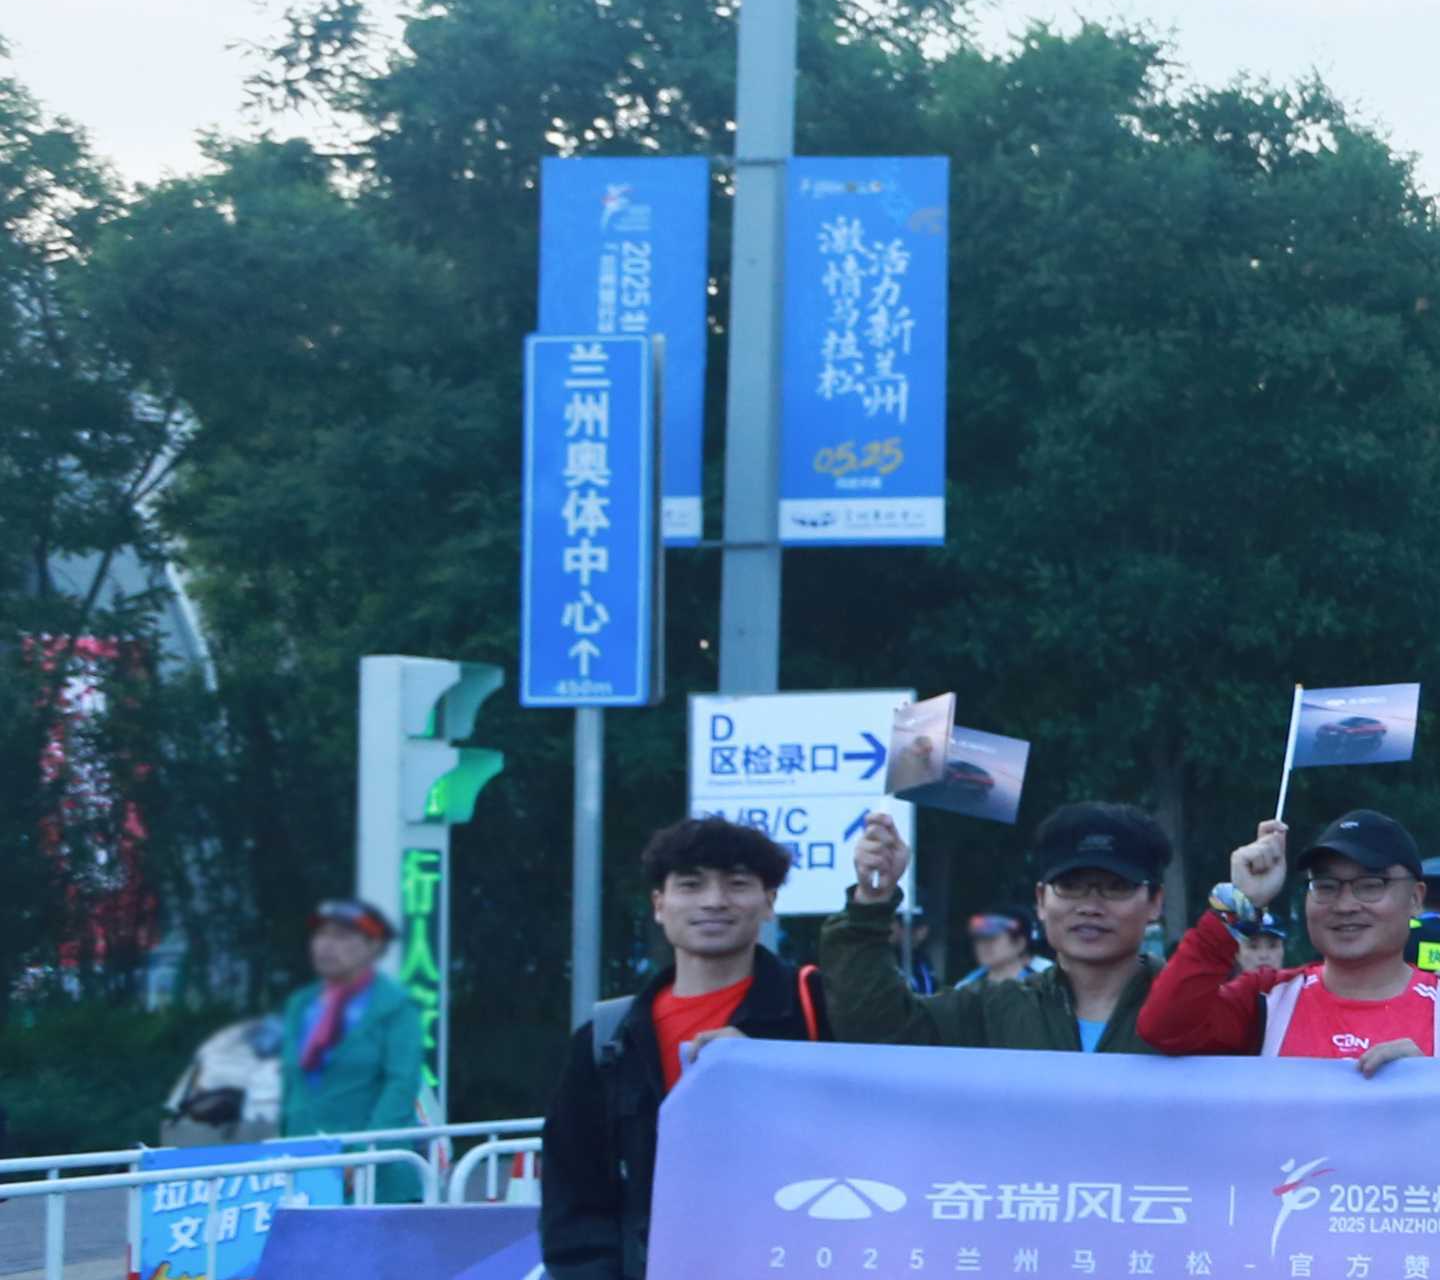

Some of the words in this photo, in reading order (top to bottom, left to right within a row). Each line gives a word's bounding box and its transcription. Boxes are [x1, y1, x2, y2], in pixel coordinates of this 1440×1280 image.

[561, 344, 611, 635] 兰州奥体中心
[711, 715, 735, 742] D
[710, 743, 840, 776] 区检录口
[925, 1181, 1194, 1225] 奇瑞风云
[1328, 1217, 1365, 1233] 2025
